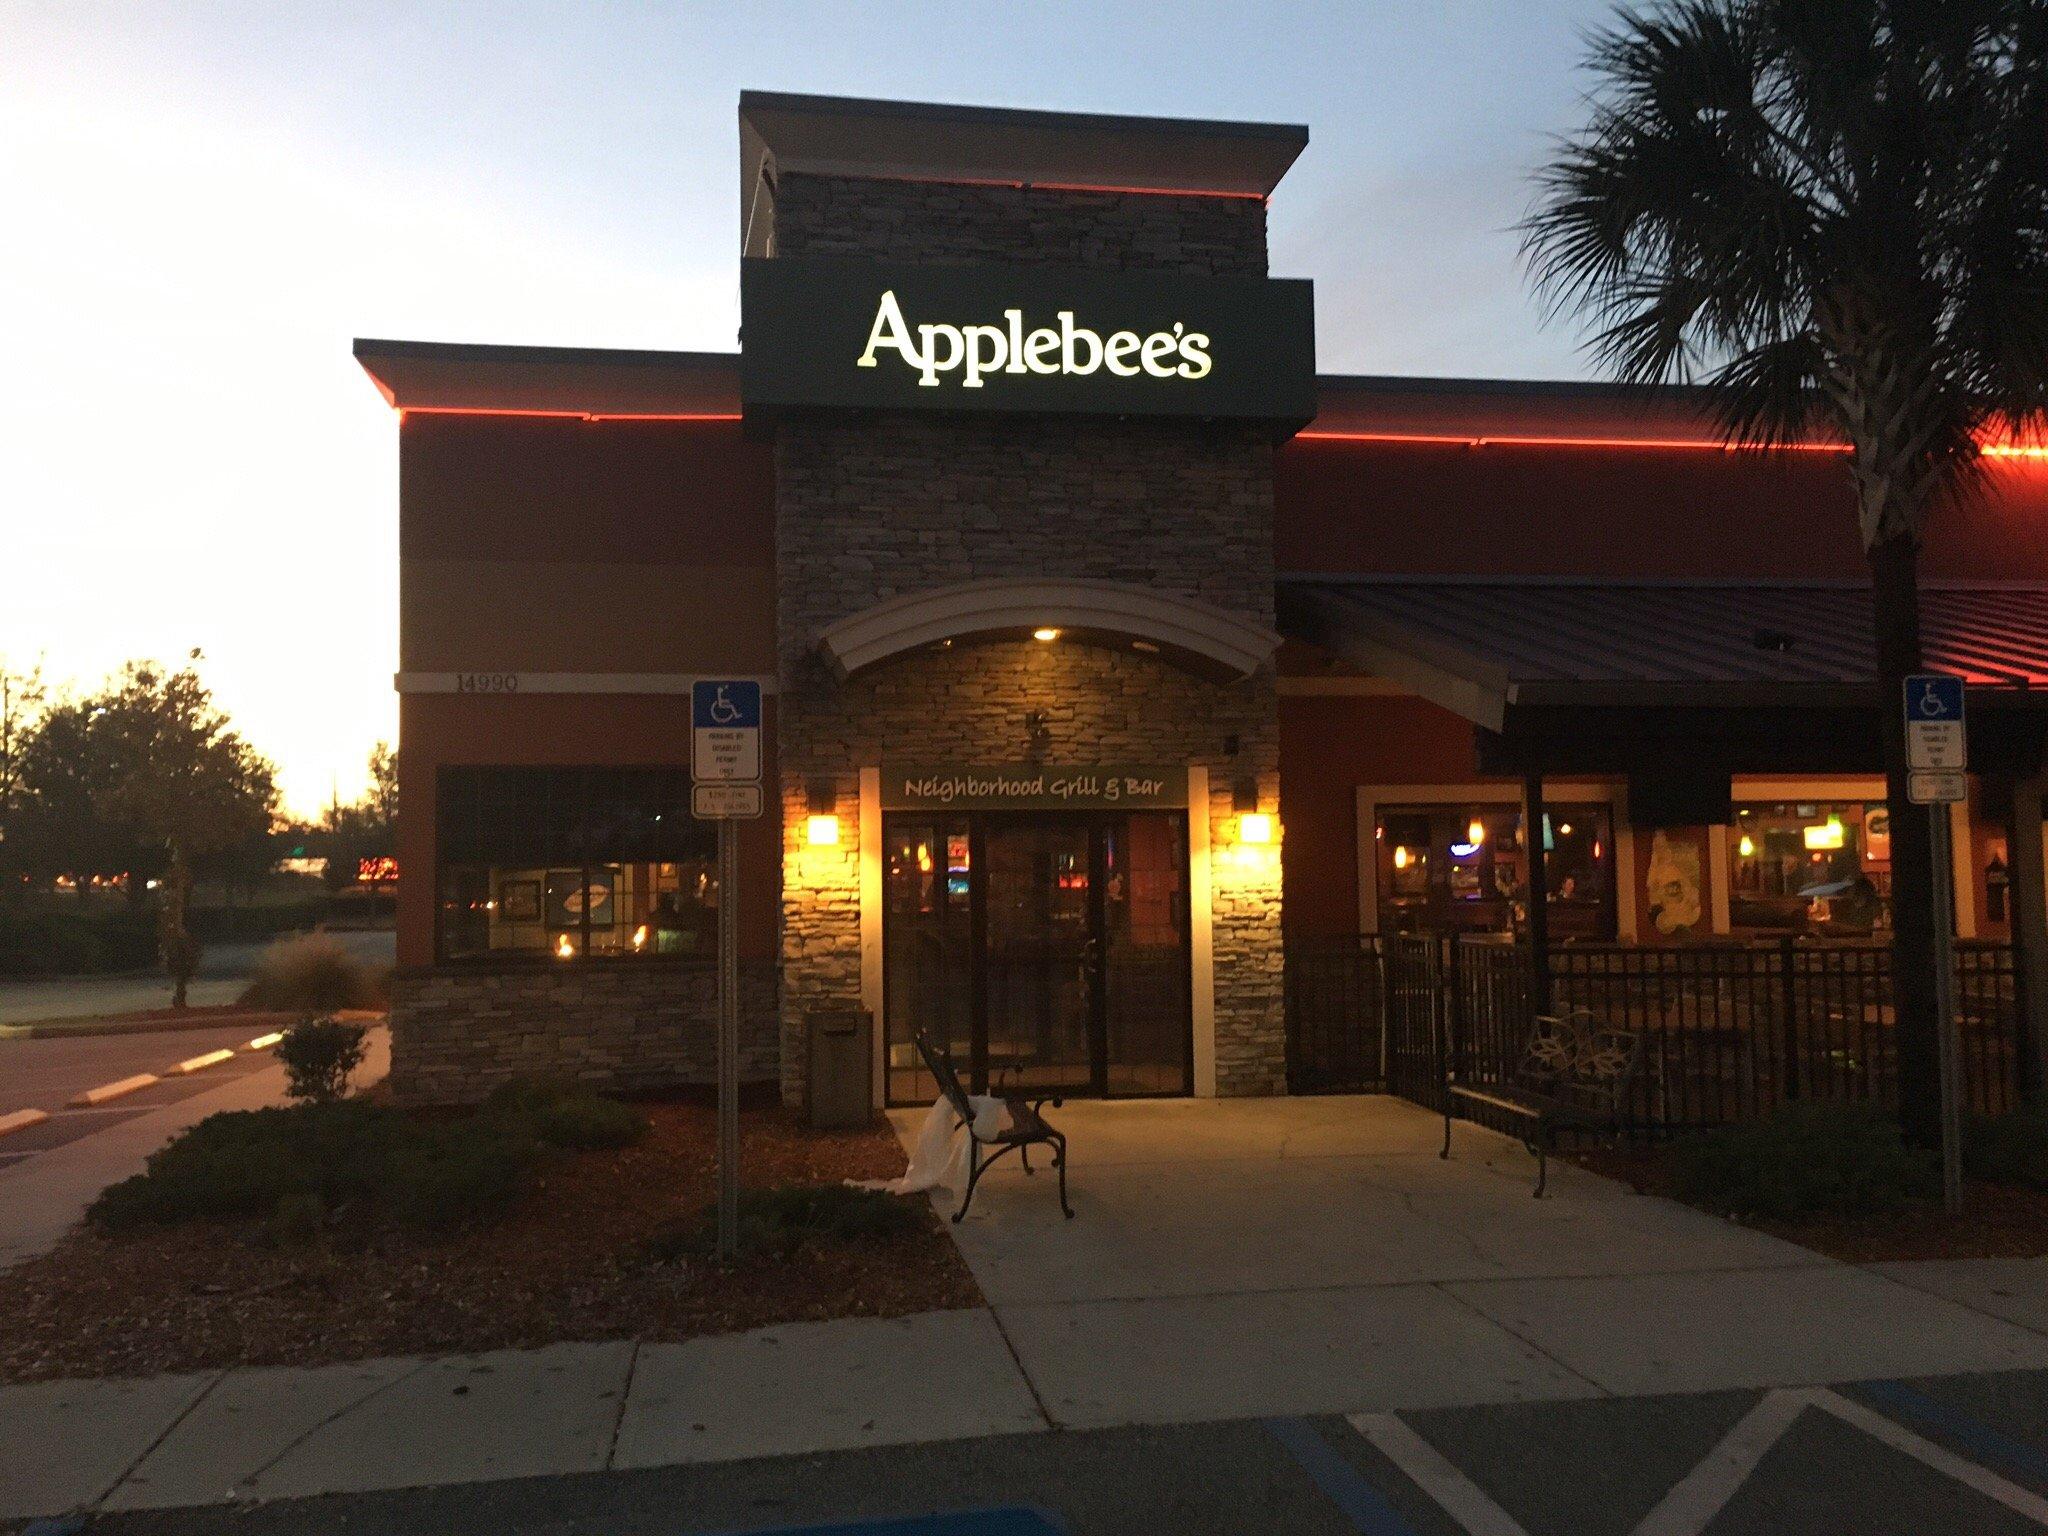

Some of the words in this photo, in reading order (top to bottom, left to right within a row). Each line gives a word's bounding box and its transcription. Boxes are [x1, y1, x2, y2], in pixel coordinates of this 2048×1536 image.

[857, 290, 1212, 387] Applebee's
[457, 674, 518, 691] 14990
[905, 775, 1043, 802] Neighborhood
[1050, 775, 1100, 799] Grill
[1103, 777, 1120, 800] &
[1126, 777, 1164, 796] Bar
